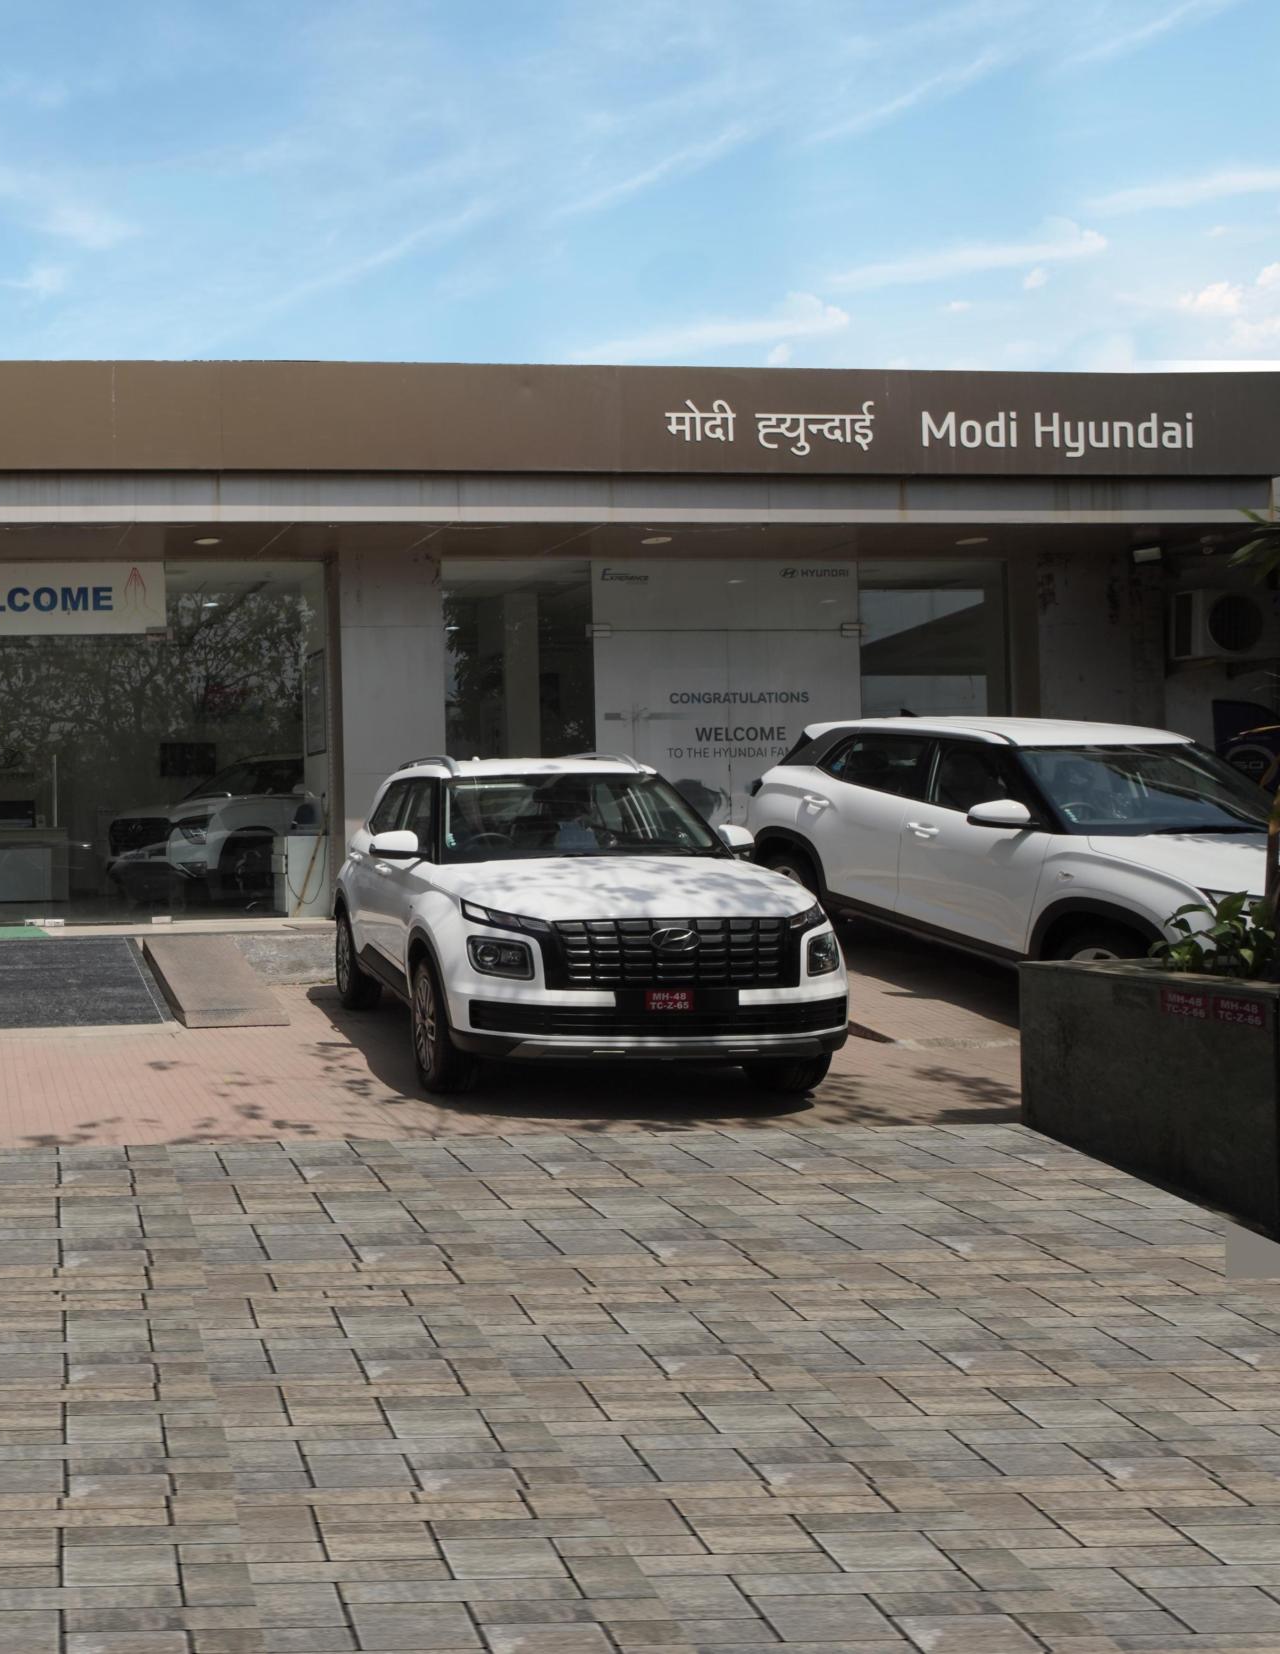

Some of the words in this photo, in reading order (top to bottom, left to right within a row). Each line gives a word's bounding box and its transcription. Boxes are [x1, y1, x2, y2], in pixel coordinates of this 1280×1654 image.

[664, 399, 737, 442] मोदी
[921, 411, 1018, 448] Modi
[1034, 411, 1194, 458] Hyundai
[800, 568, 849, 578] HYUNDAI
[669, 691, 810, 705] CONGRATULATIONS
[695, 726, 787, 742] WELCOME
[667, 748, 684, 759] TO
[688, 748, 710, 759] THE
[713, 747, 768, 759] HYUNDAI
[652, 992, 687, 1001] MH-48
[649, 1001, 689, 1010] TC-Z-65
